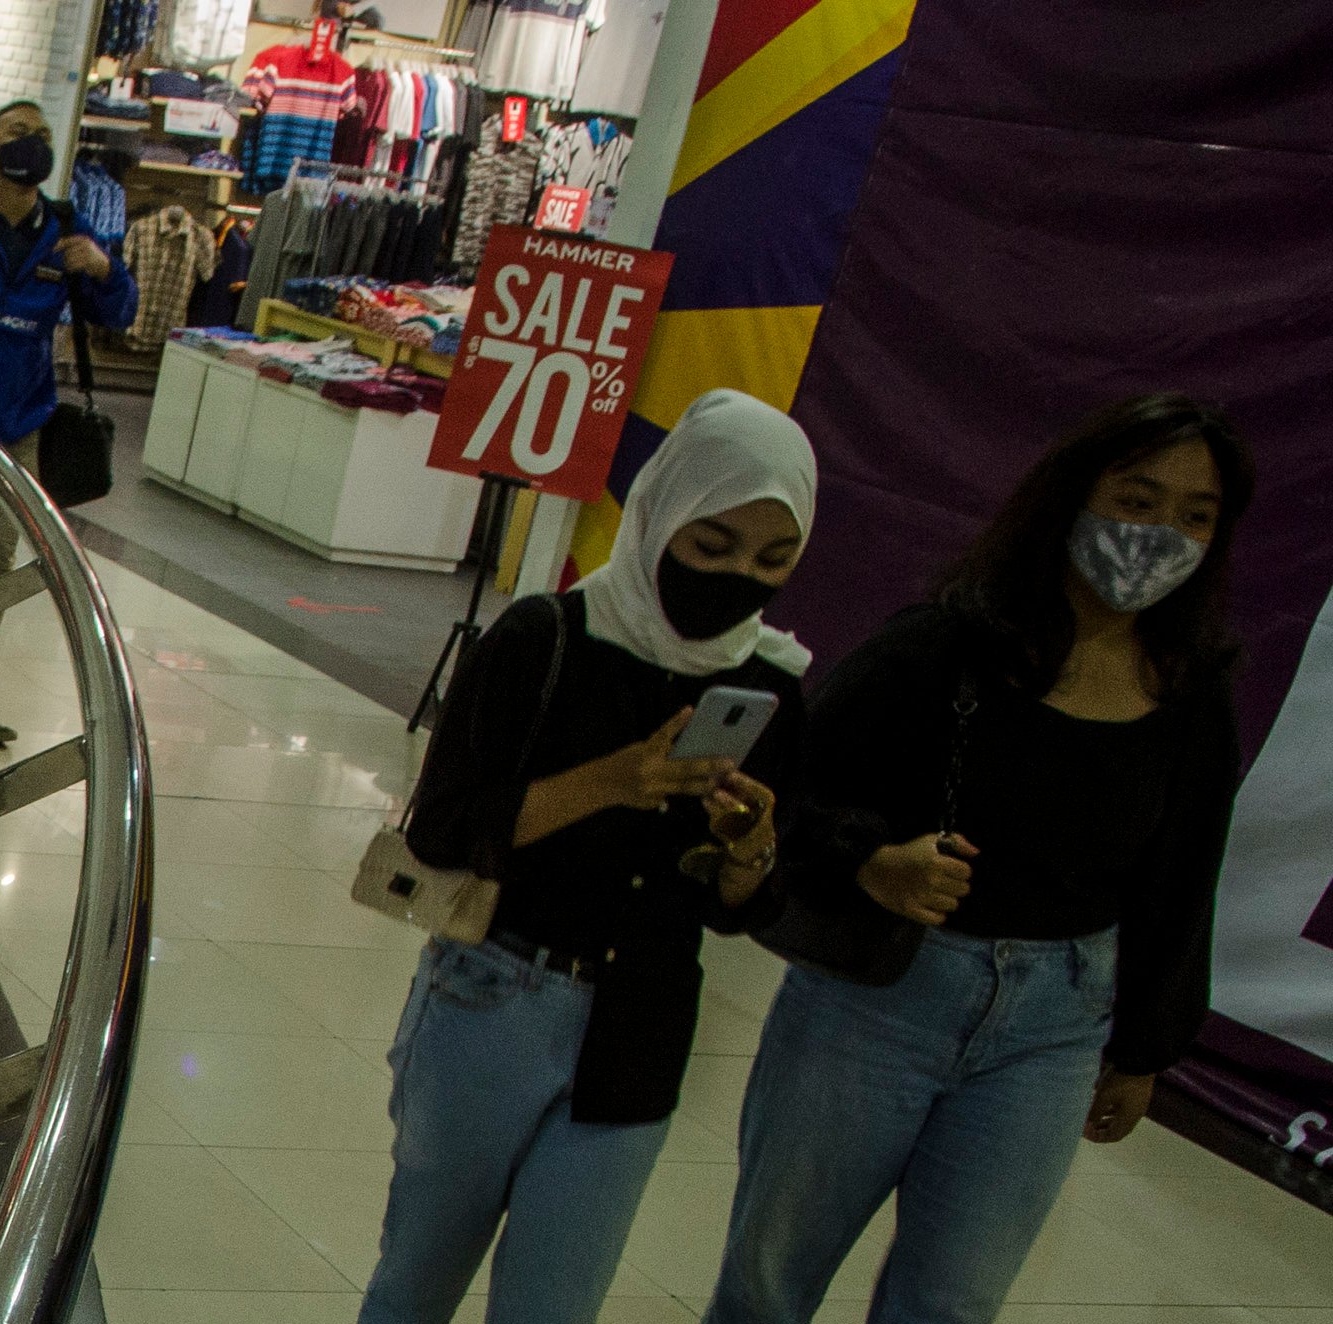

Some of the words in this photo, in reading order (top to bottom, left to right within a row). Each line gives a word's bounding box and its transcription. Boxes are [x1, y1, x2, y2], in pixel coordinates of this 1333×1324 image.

[542, 198, 578, 230] SALE
[523, 236, 635, 272] HAMMER
[484, 264, 646, 360] SALE
[592, 397, 618, 413] off
